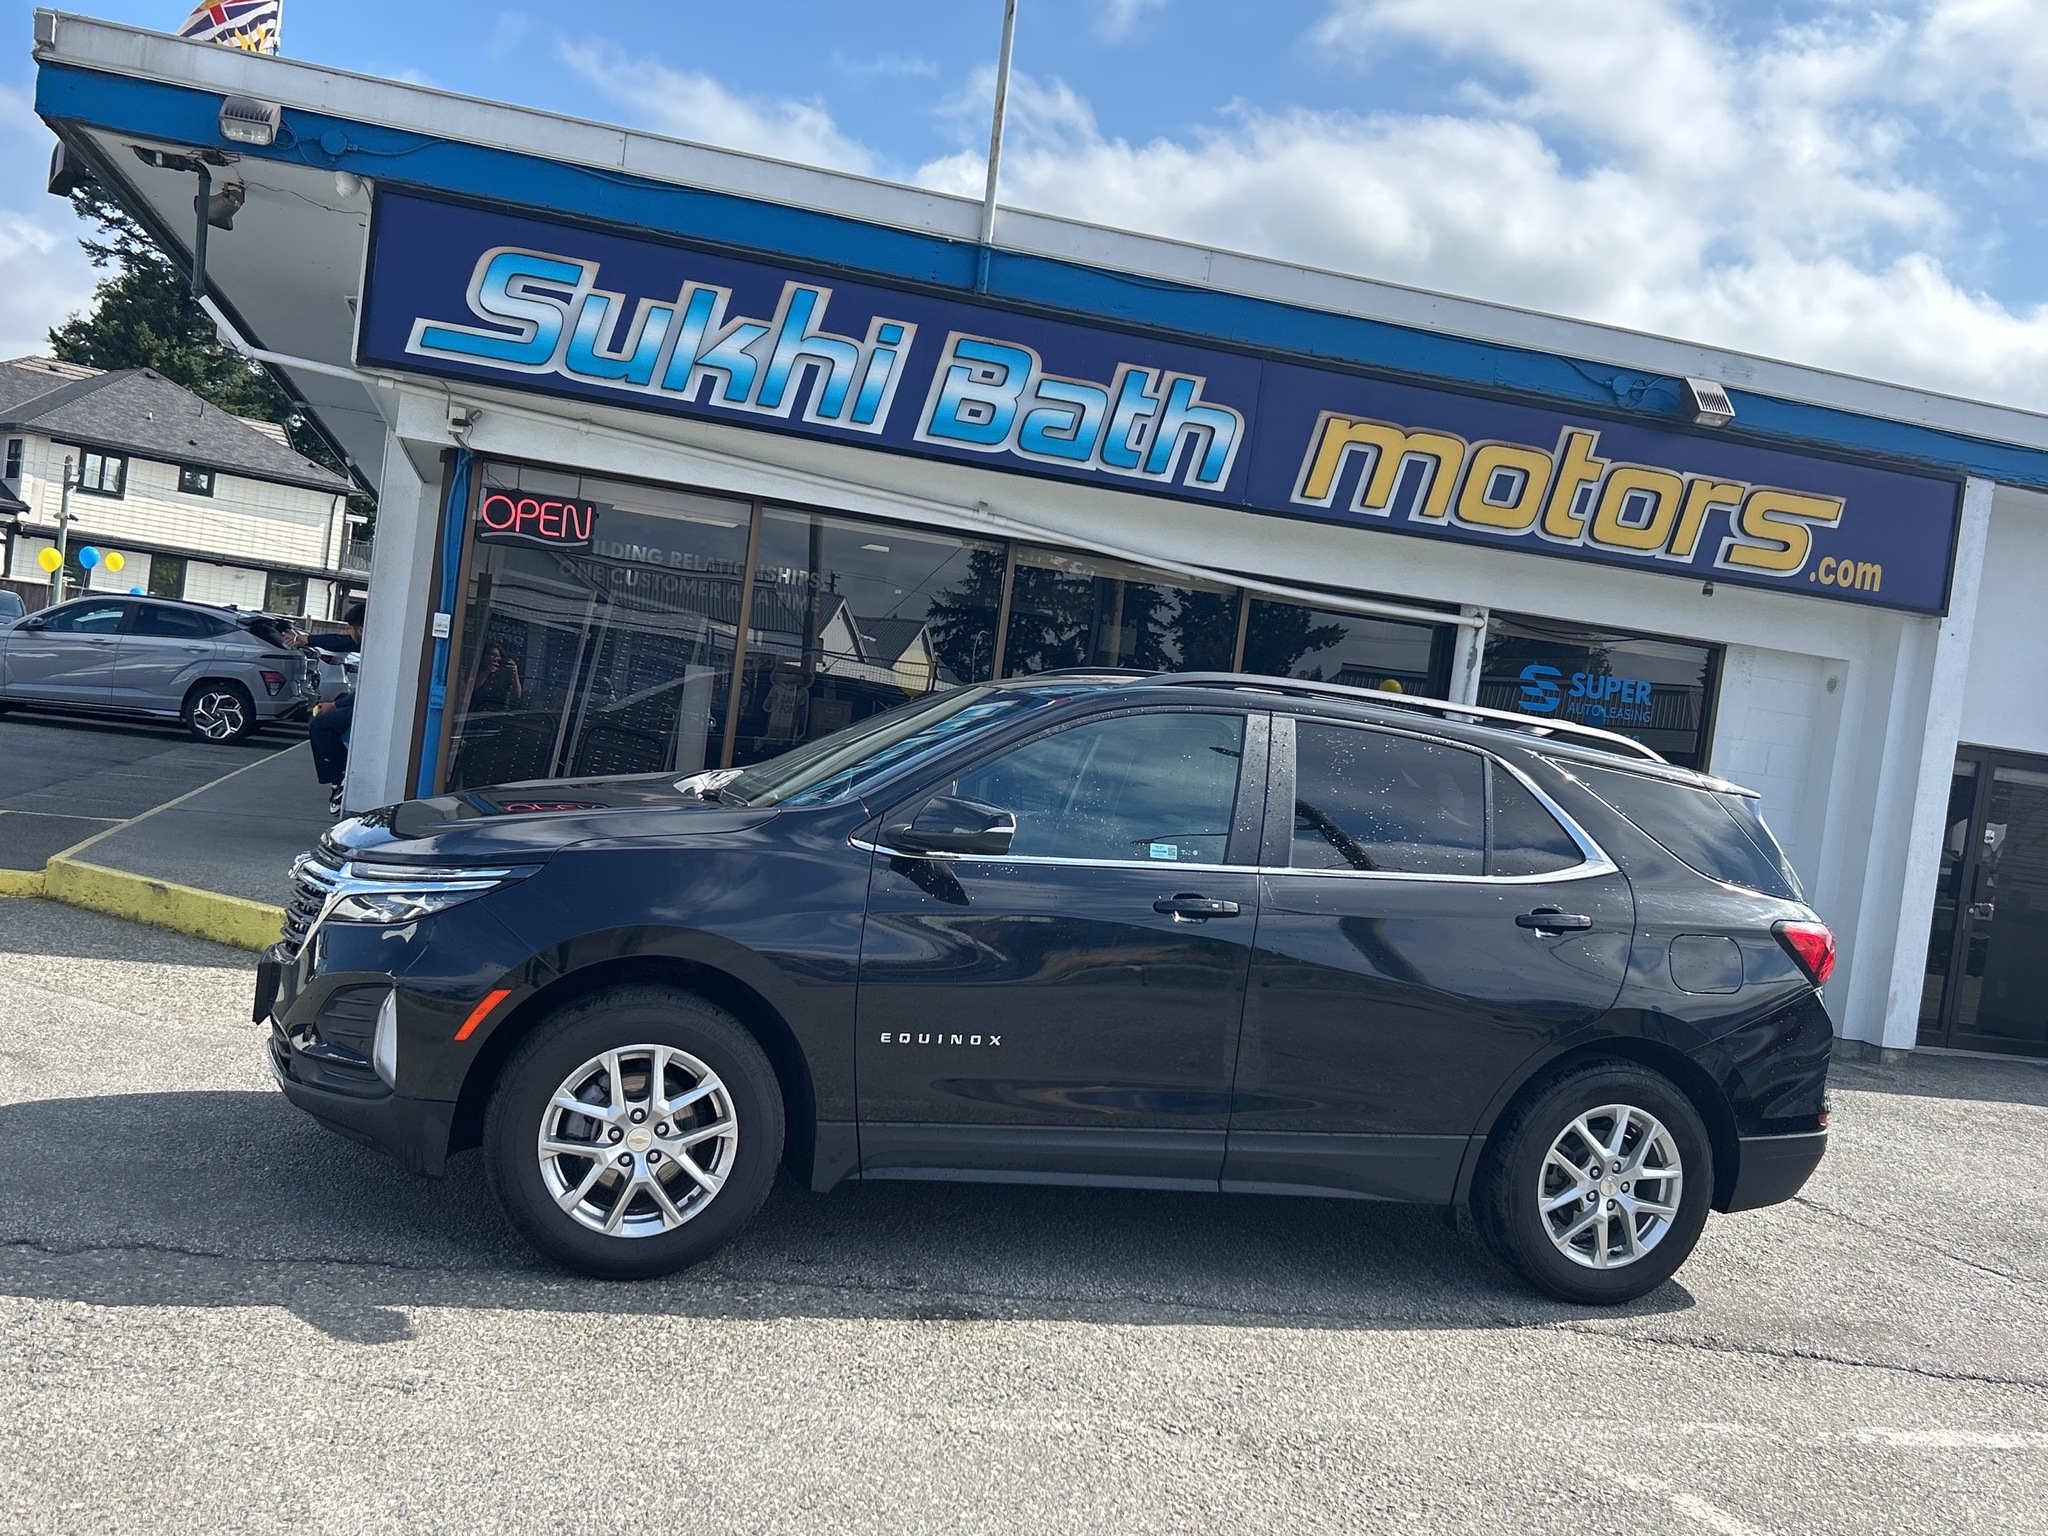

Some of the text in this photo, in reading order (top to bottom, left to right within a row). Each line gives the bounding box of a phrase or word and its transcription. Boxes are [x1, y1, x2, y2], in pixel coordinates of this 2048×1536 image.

[405, 246, 1882, 592] Sukhi Bath motors .com
[482, 494, 592, 540] OPEN
[593, 539, 665, 565] ILDING
[611, 568, 721, 599] CUSTOMER
[1568, 672, 1652, 705] SUPER
[1566, 702, 1651, 723] AUTO LEASING
[880, 1032, 1001, 1046] EQUINOX
